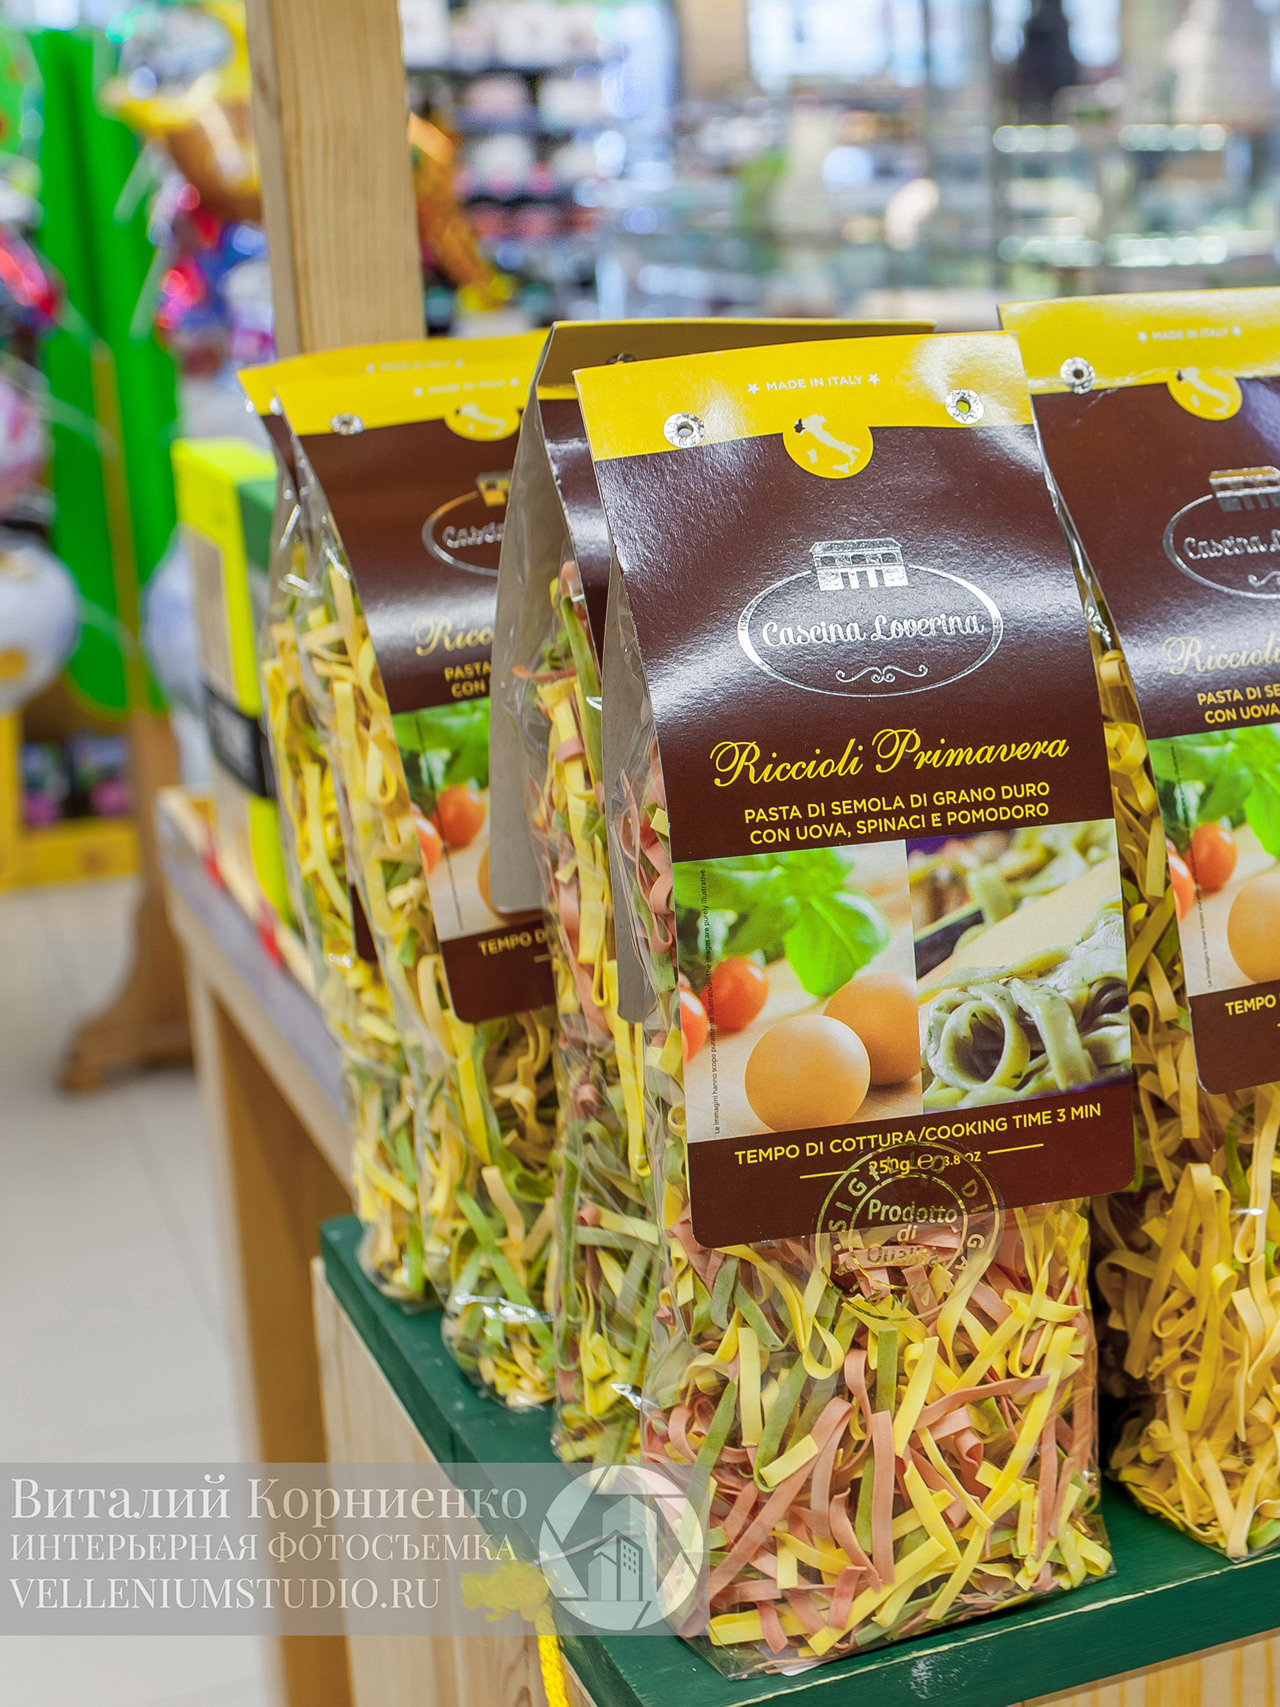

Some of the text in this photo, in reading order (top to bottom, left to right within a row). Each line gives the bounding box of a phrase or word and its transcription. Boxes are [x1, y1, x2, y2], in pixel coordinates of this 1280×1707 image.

[765, 374, 863, 392] MADE IN ITALY
[1183, 534, 1267, 560] Cascina
[410, 615, 494, 656] Ricc
[762, 613, 985, 648] Cascina Loverina
[444, 660, 491, 682] PASTA
[451, 679, 486, 698] CON
[1197, 688, 1243, 706] PASTA
[1246, 686, 1261, 700] DI
[1204, 707, 1237, 725] CON
[709, 728, 1069, 787] Riccioli Primavera
[744, 781, 1050, 824] PASTA DI SEMOLA DI GRANO DURO
[750, 802, 1050, 845] CON UOVA, SPINACI E POMODORO
[702, 906, 710, 926] purely
[478, 931, 532, 956] TEMPO
[705, 939, 713, 962] images
[1225, 996, 1277, 1016] TEMPO
[708, 1017, 717, 1052] puramente
[710, 1053, 718, 1072] scopo
[711, 1073, 719, 1094] hanno
[712, 1095, 721, 1126] immagini
[714, 1126, 721, 1135] Le
[734, 1102, 1101, 1166] TEMPO DI COTTURA/COOKING TIME 3 MIN
[867, 1198, 958, 1224] Prodotto
[896, 1225, 918, 1243] di
